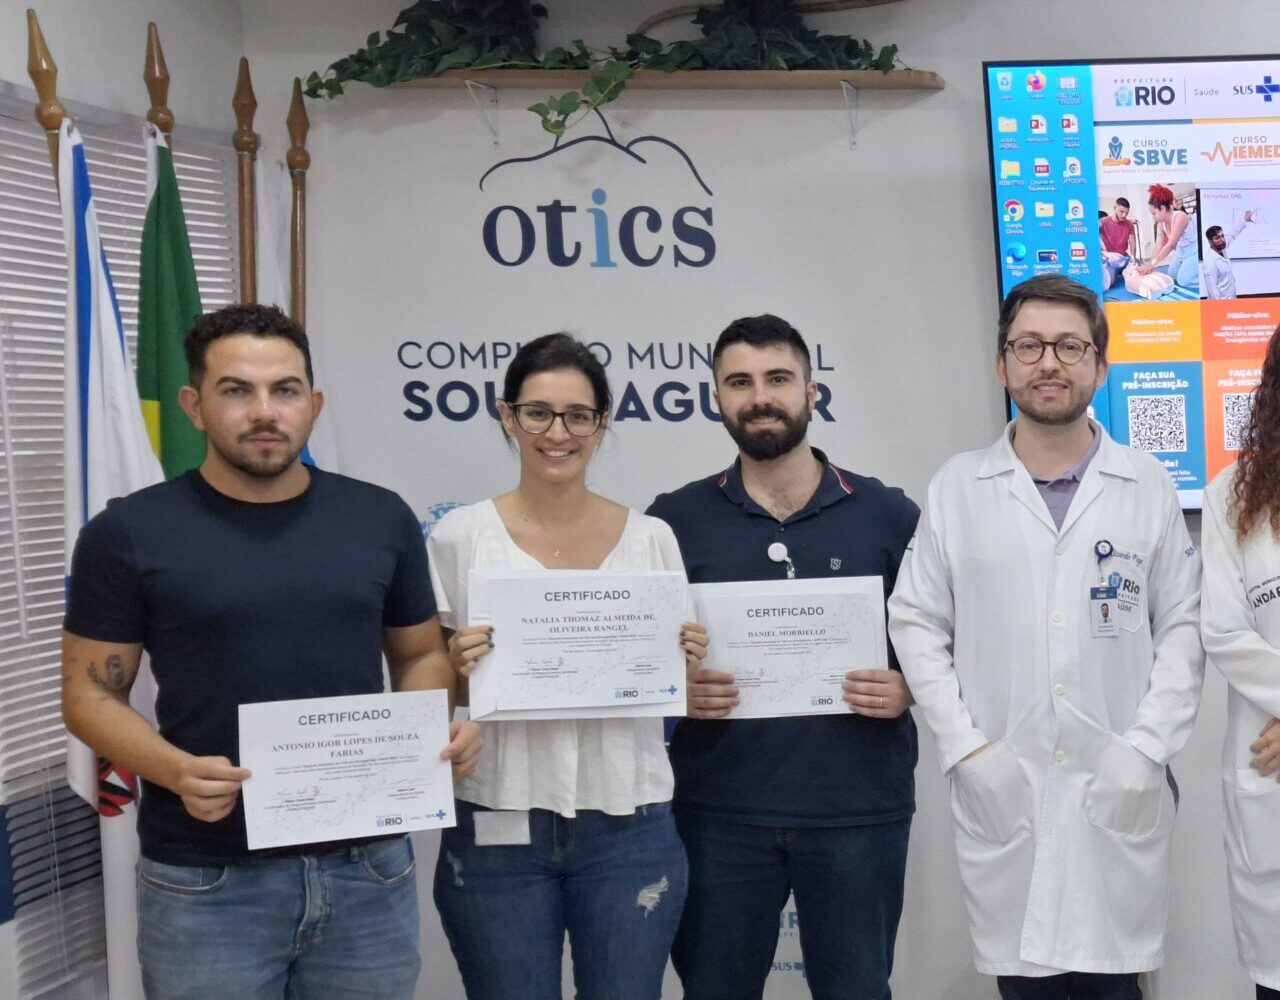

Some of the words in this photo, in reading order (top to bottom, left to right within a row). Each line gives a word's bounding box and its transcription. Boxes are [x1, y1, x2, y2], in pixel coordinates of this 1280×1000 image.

[1193, 88, 1219, 96] Saúde
[1233, 85, 1253, 95] SUS
[1135, 86, 1175, 106] RIO
[1133, 140, 1168, 148] CURSO
[1233, 136, 1267, 144] CURSO
[1133, 149, 1188, 165] SBVE
[482, 187, 717, 268] otics
[1134, 372, 1158, 380] FAÇA
[1228, 369, 1249, 378] FAÇA
[1122, 379, 1189, 390] PRÉ-INSCRIÇÃO
[614, 381, 837, 422] AGUR
[1123, 579, 1140, 594] Rio
[544, 590, 631, 602] CERTIFICADO
[746, 606, 825, 618] CERTIFICADO
[521, 616, 560, 624] NATALIA
[563, 615, 601, 623] THOMAZ
[602, 614, 642, 622] ALMEIDA
[550, 626, 592, 634] OLIVEIRA
[748, 630, 776, 638] DANIEL
[623, 690, 639, 698] RIO
[818, 698, 833, 706] RIO
[298, 708, 392, 726] CERTIFICADO
[272, 742, 315, 752] ANTONIO
[317, 740, 342, 748] IGOR
[344, 737, 373, 746] LOPES
[387, 733, 420, 742] SOUZA
[330, 749, 365, 758] FARIAS
[385, 817, 403, 826] RIO
